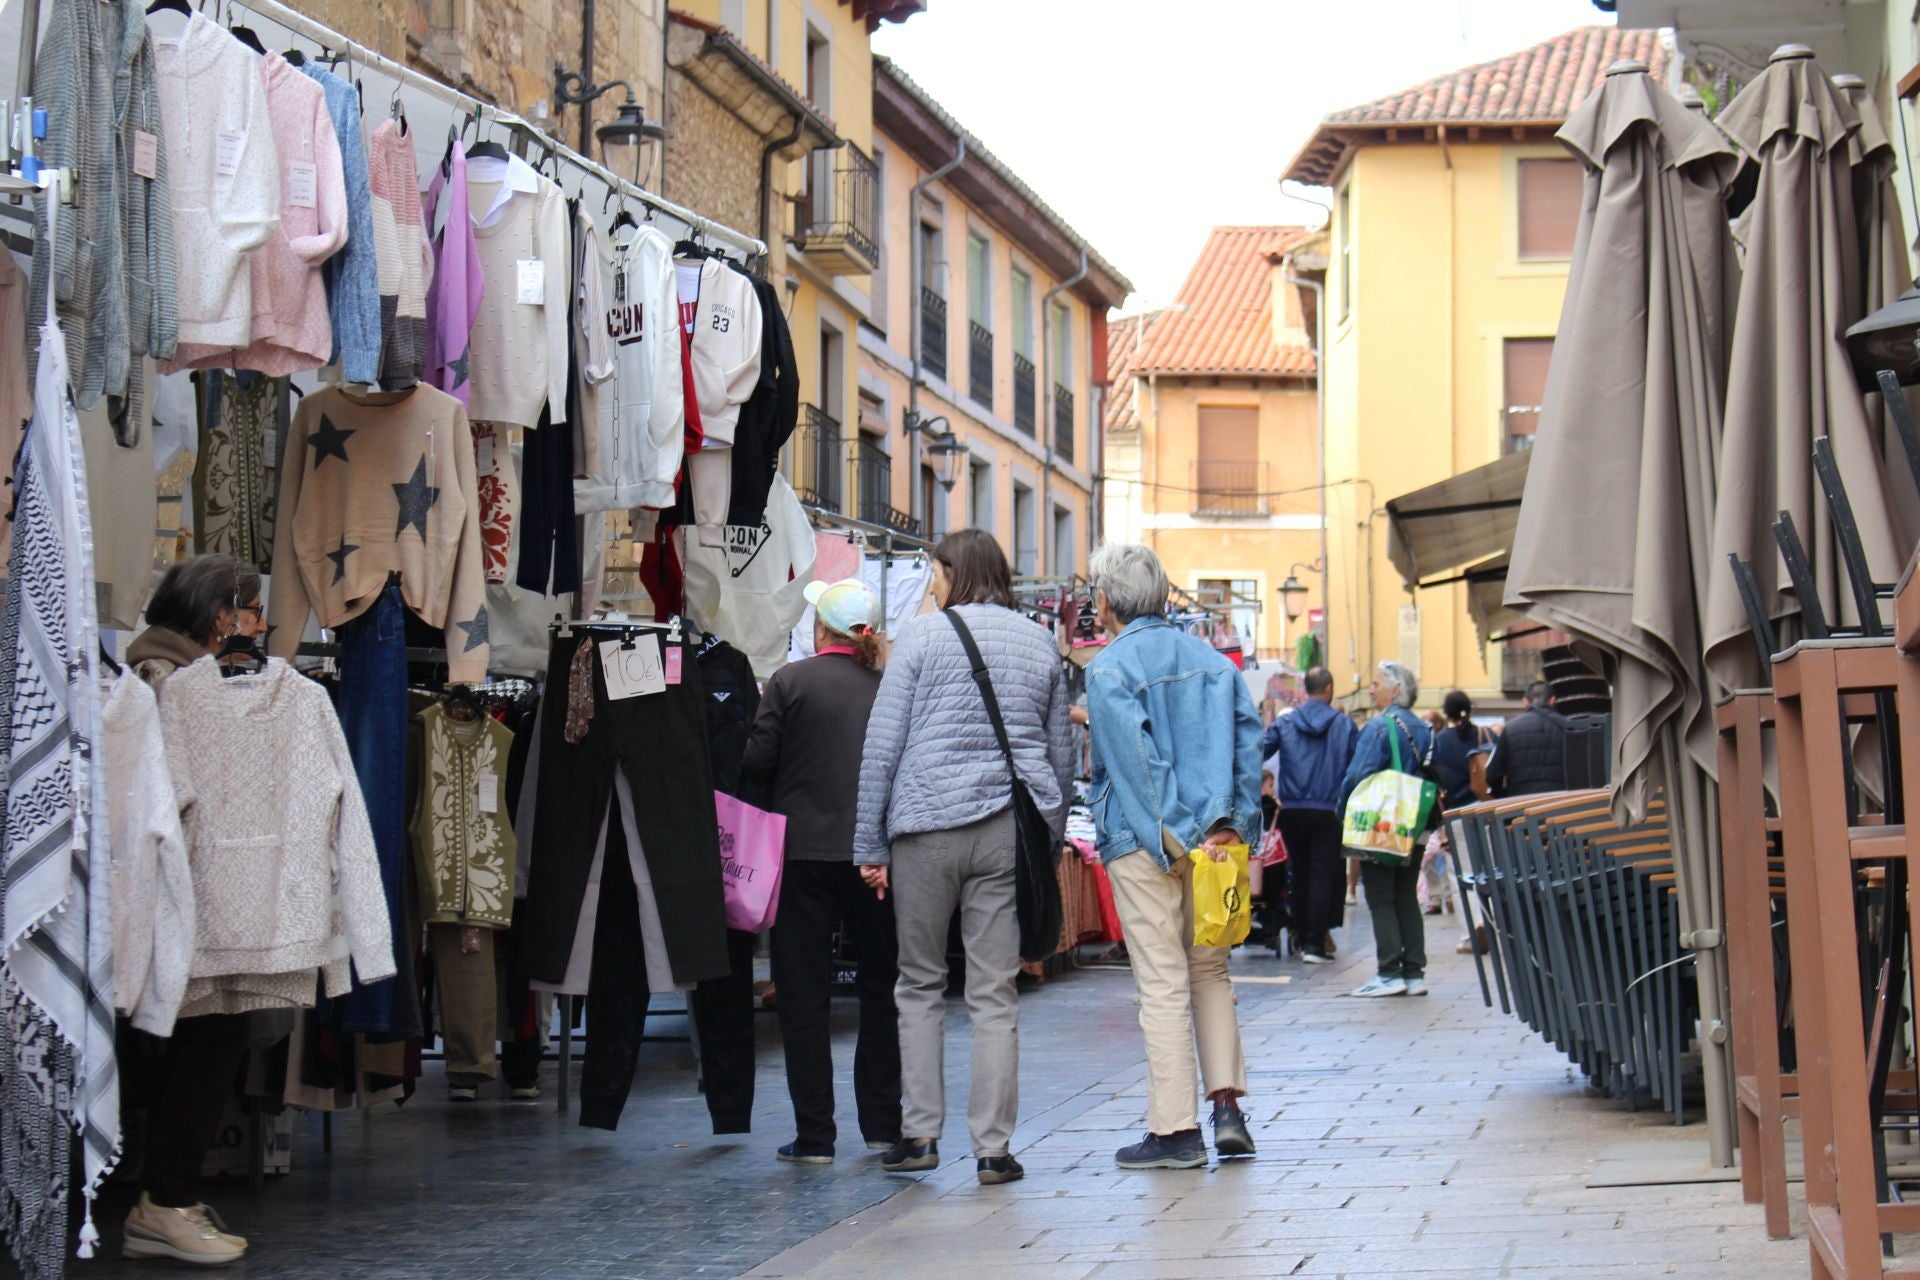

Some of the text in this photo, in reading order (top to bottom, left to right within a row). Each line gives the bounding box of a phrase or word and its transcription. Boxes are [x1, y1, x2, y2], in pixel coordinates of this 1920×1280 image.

[711, 303, 736, 319] CHICAGO
[712, 314, 729, 333] 23
[604, 646, 657, 687] 10€
